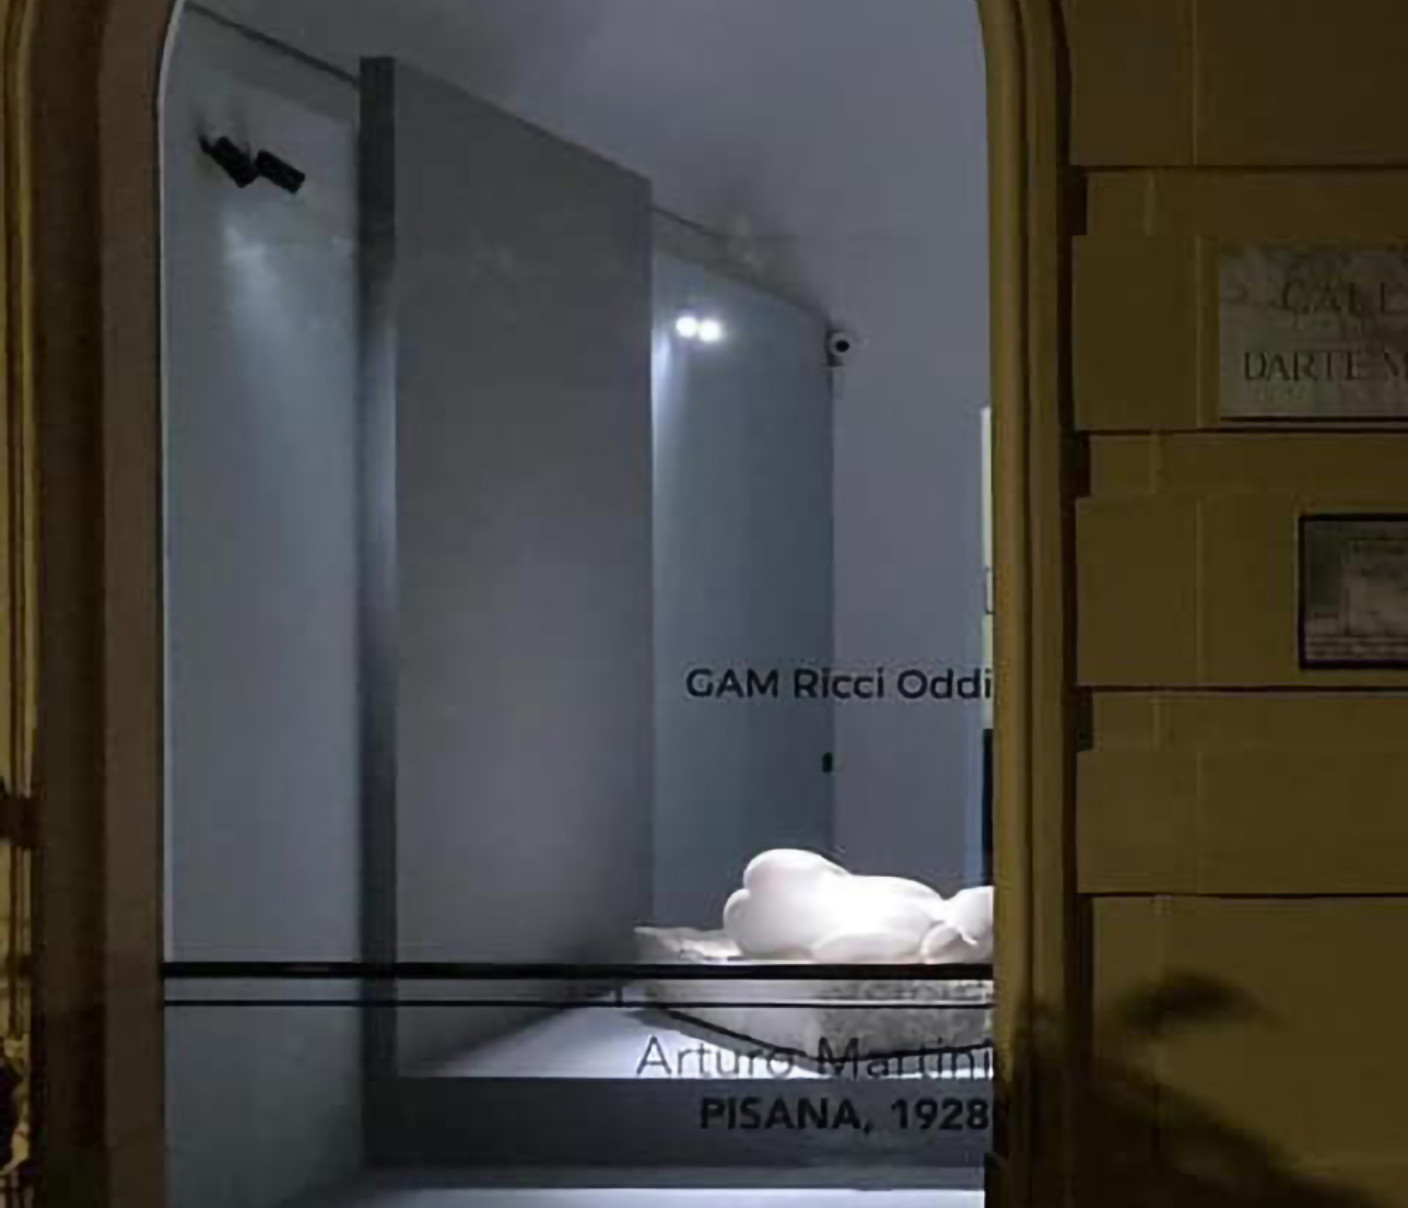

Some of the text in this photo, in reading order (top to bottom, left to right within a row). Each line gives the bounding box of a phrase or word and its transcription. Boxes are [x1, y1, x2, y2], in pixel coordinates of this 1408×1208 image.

[685, 666, 993, 701] GAM Ricci Oddi
[636, 1035, 993, 1078] Arturo Martini
[700, 1097, 991, 1133] PISANA, 1928
